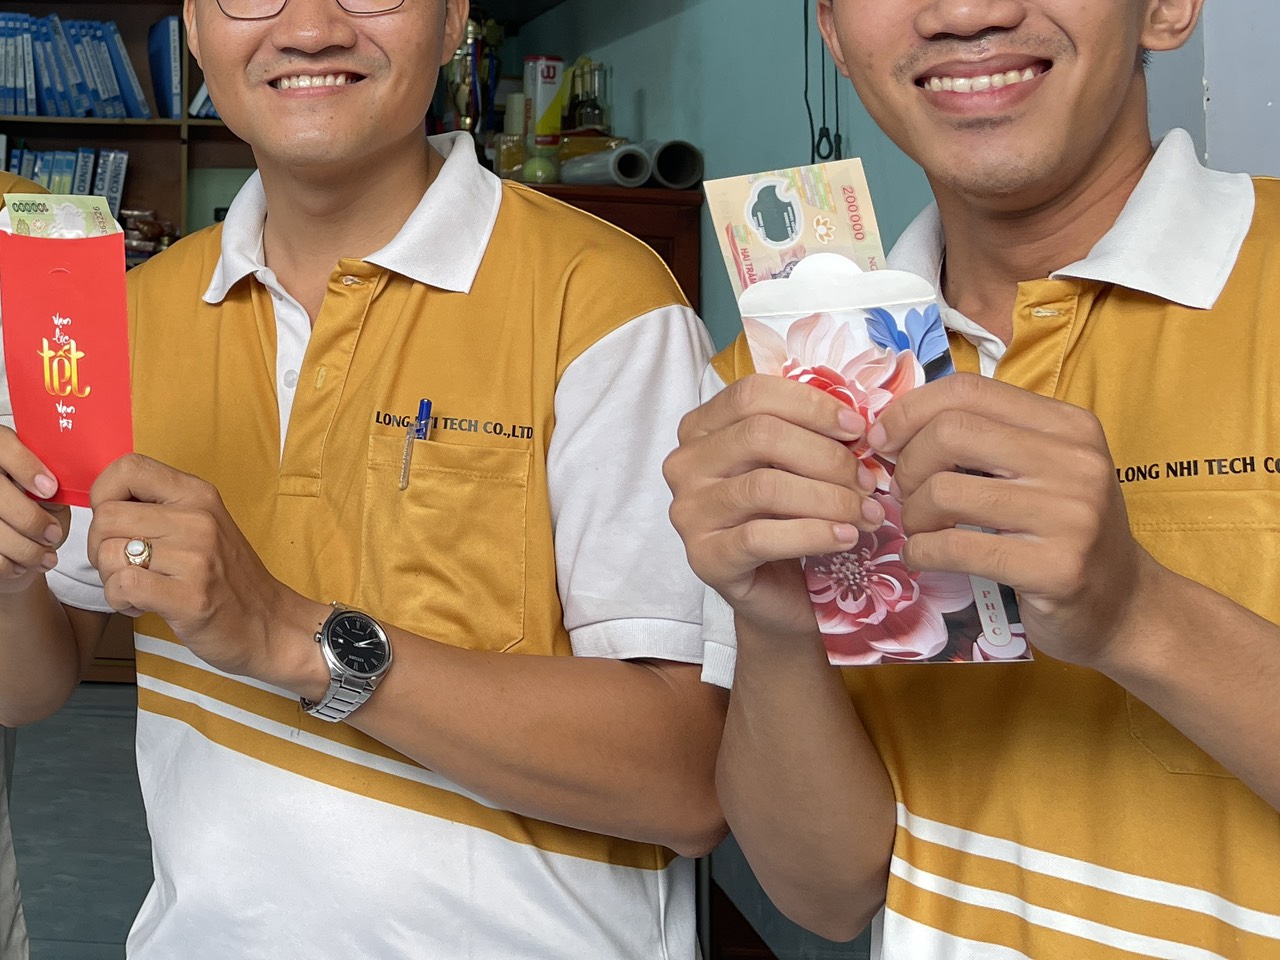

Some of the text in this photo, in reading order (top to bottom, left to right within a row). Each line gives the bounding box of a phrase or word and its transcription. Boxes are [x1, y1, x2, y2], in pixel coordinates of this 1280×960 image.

[77, 153, 91, 193] SHINKO
[375, 411, 410, 428] LONG
[442, 417, 479, 433] TECH
[483, 420, 534, 439] CO.,LTD
[1116, 463, 1160, 484] LONG
[1166, 460, 1198, 478] NHI
[1204, 456, 1256, 476] TECH
